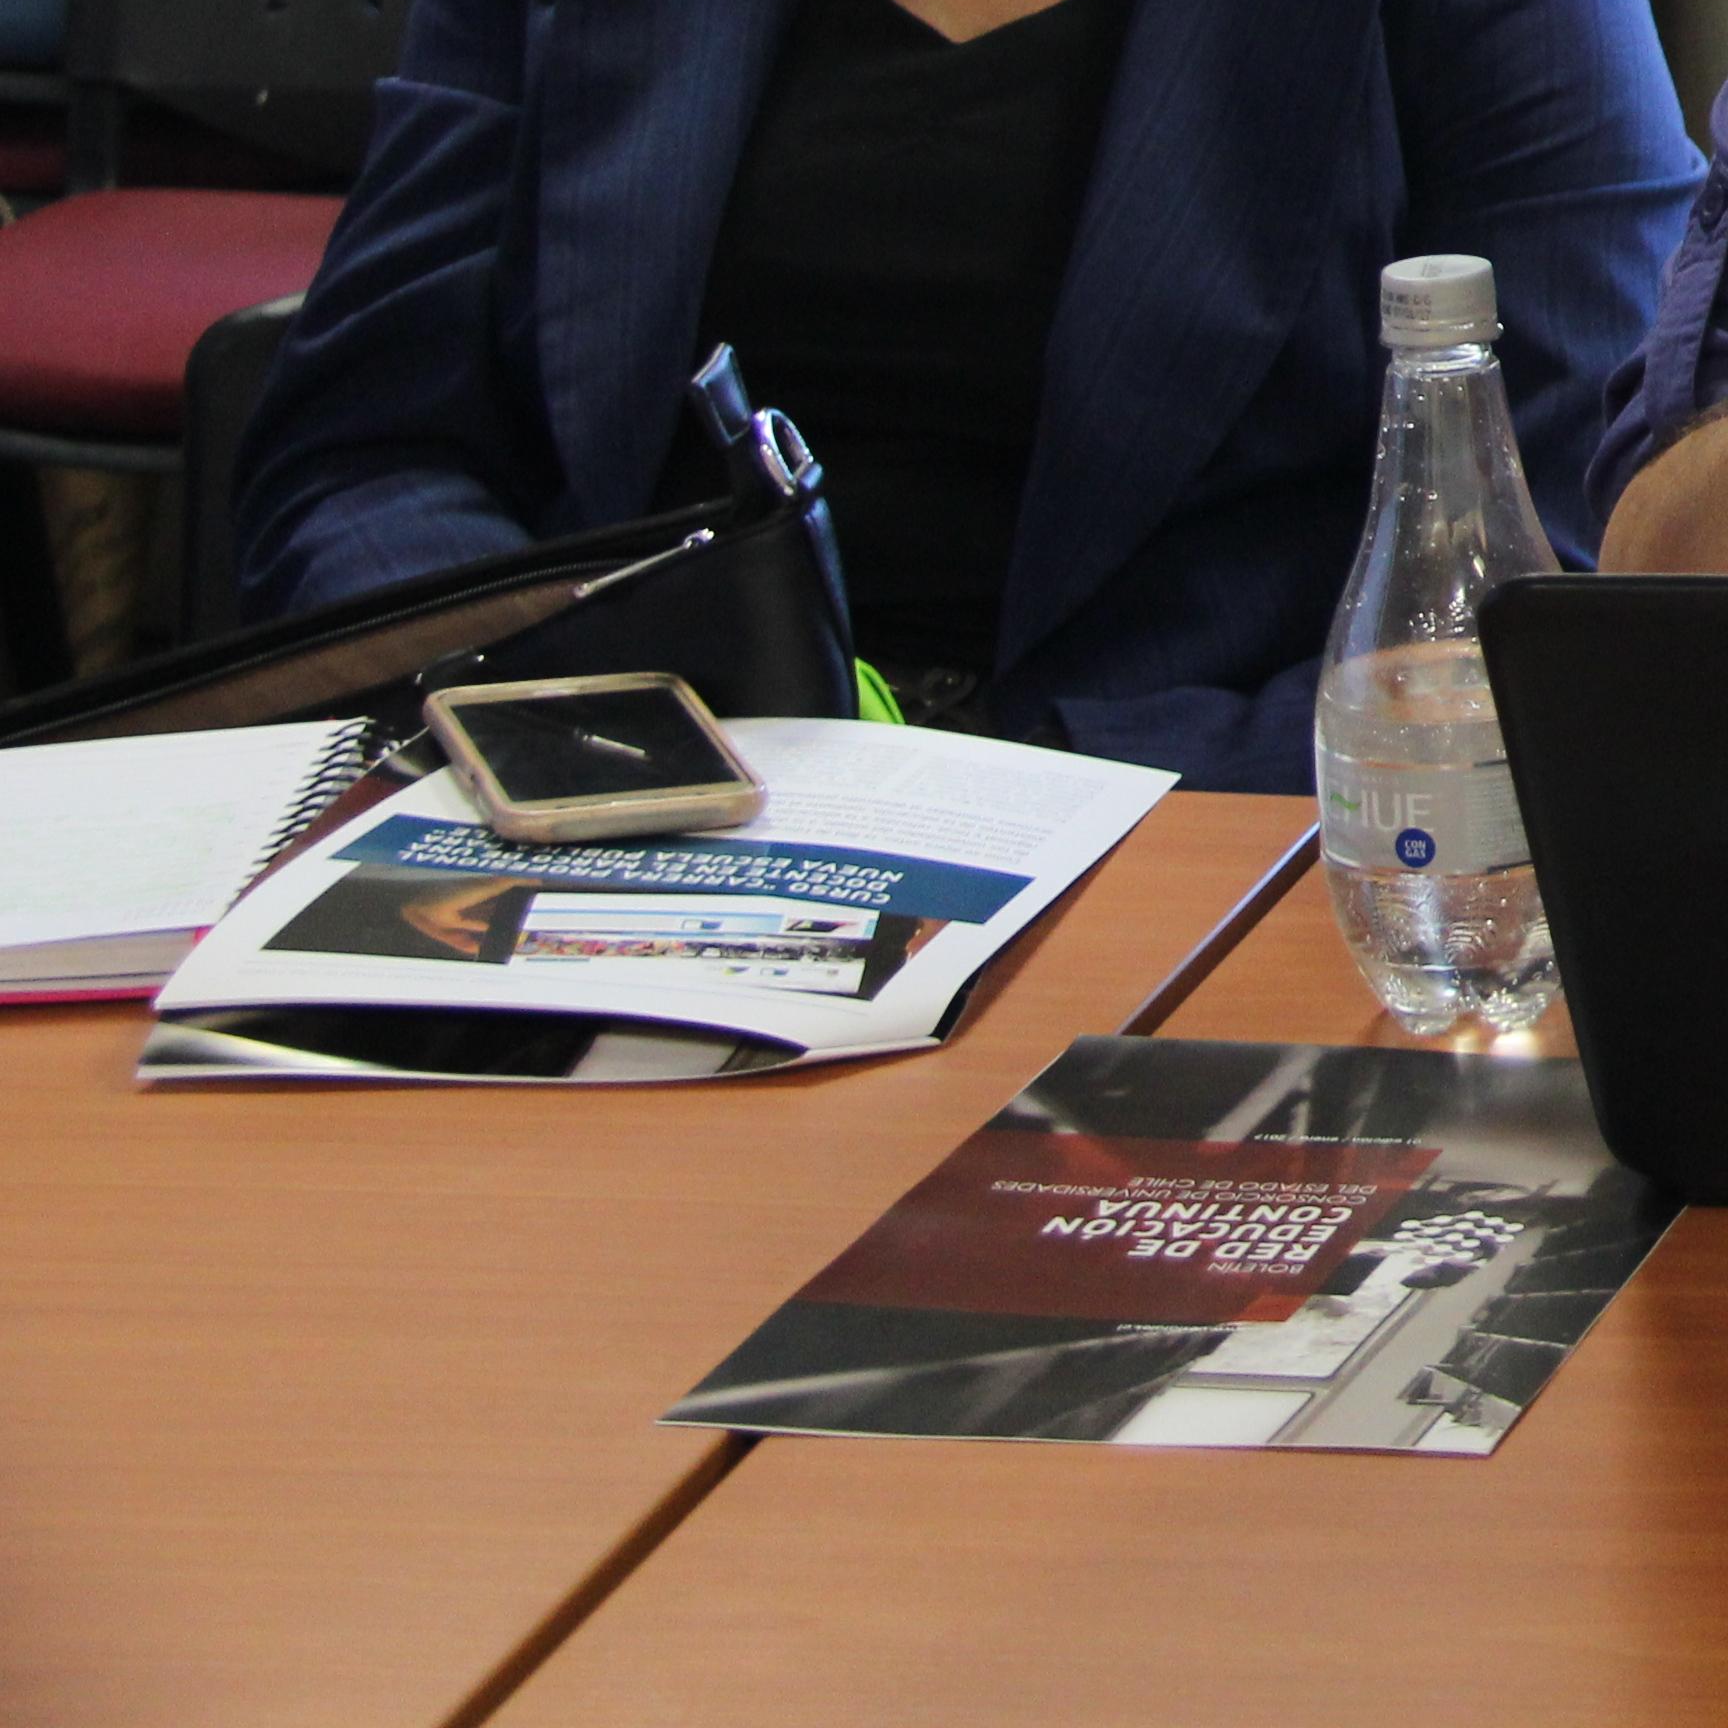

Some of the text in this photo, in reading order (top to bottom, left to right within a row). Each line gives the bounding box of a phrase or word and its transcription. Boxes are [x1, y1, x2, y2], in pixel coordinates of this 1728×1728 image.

[1404, 839, 1427, 849] CON
[1404, 848, 1427, 859] GAS
[400, 852, 613, 879] PROFESIONAL
[410, 842, 889, 892] DOCENTE EN EL MARCO DE UNA
[655, 851, 793, 870] ESCUELA
[802, 859, 903, 884] NUEVA
[787, 882, 892, 905] CURSO
[1253, 1132, 1286, 1143] 2017
[1299, 1133, 1340, 1144] enero
[990, 1180, 1368, 1205] CONSORCIO DE UNIVERSIDADES
[1127, 1175, 1379, 1195] DEL ESTADO DE CHILE
[1098, 1199, 1353, 1224] CONTINUA
[1040, 1216, 1338, 1242] EDUCACIÓN
[1127, 1238, 1321, 1262] RED DE
[1206, 1261, 1305, 1275] BOLETÍN
